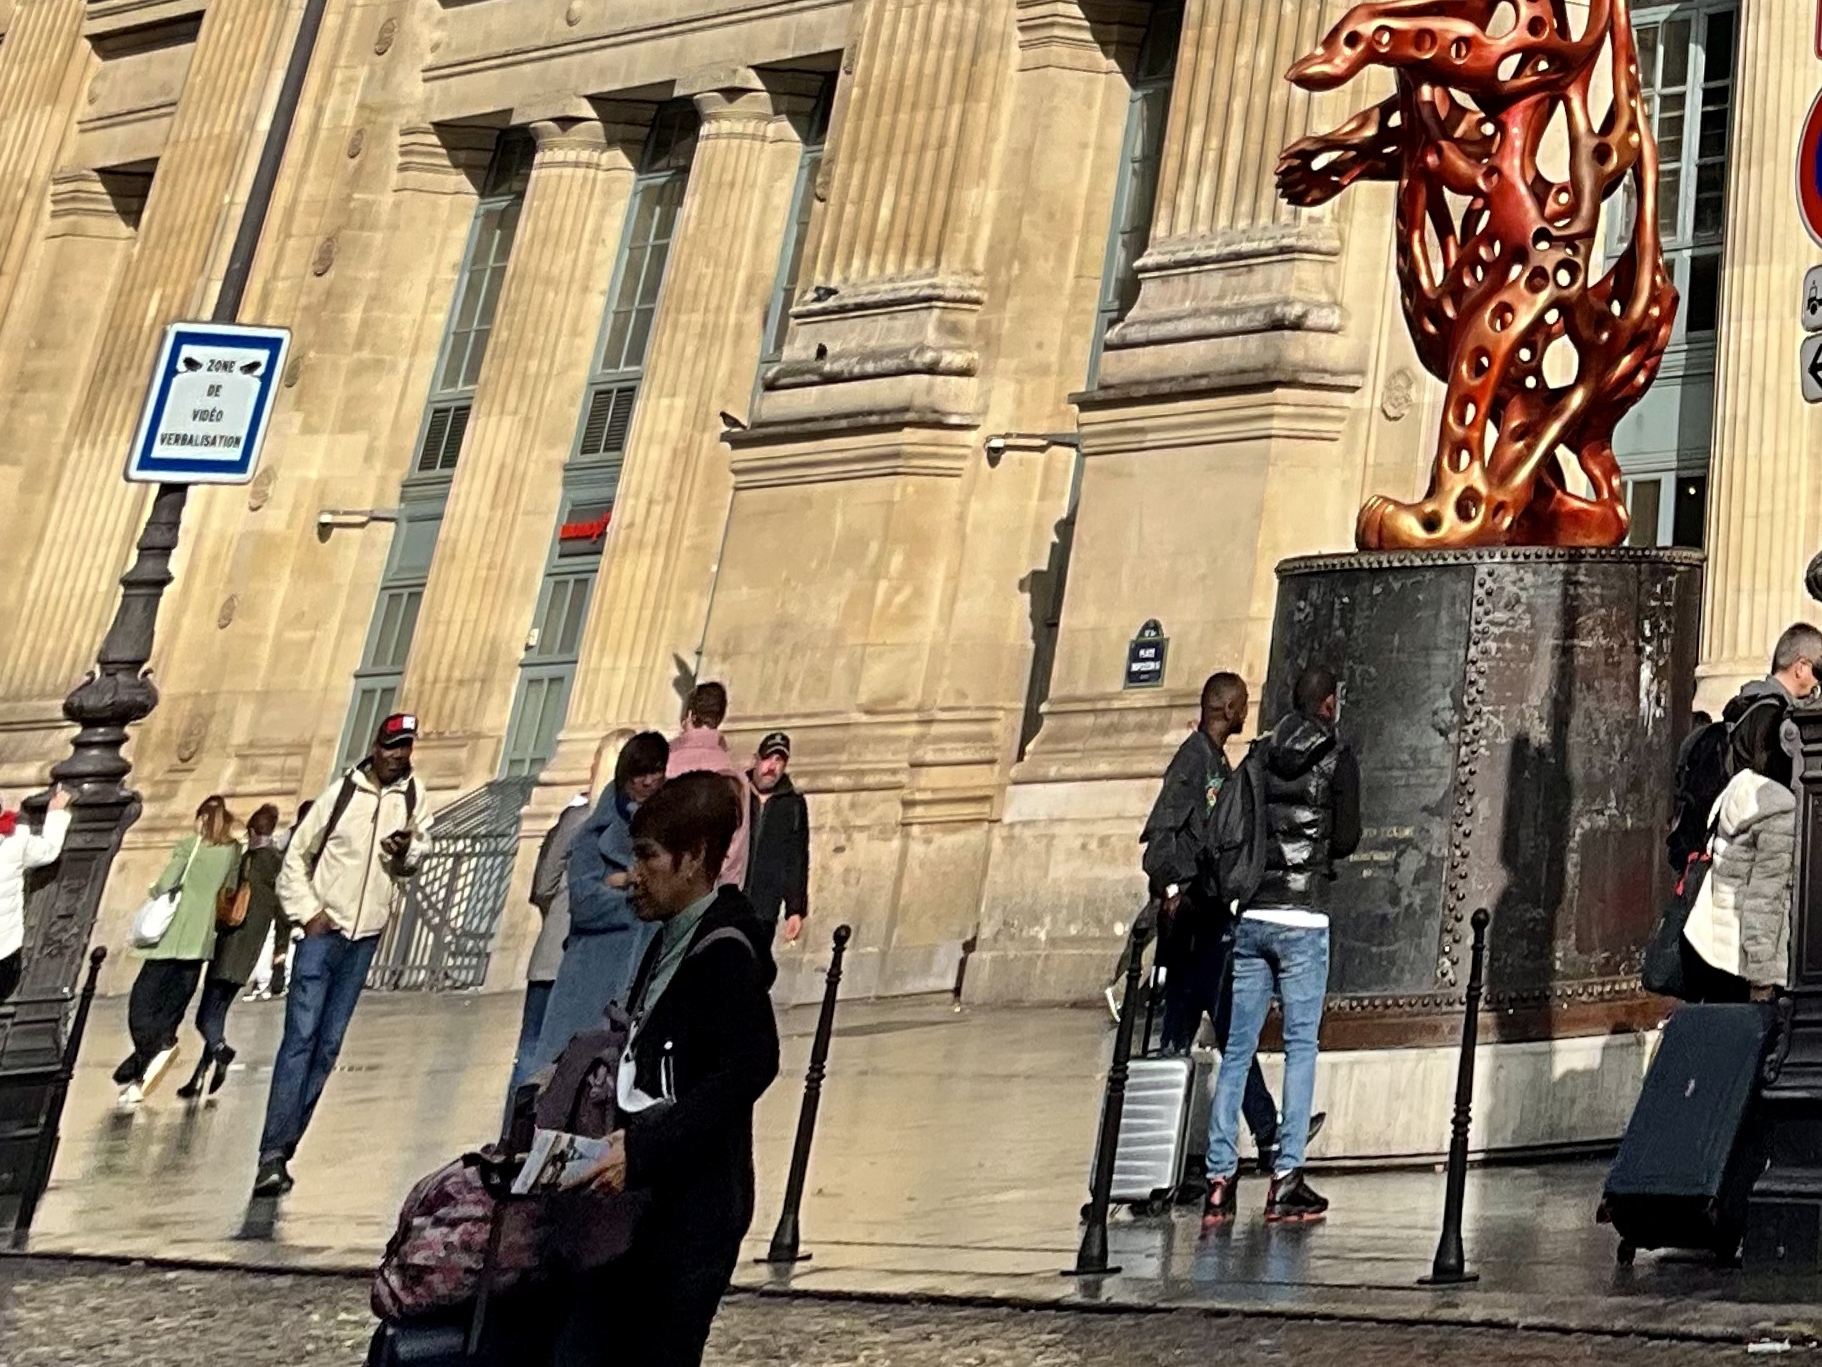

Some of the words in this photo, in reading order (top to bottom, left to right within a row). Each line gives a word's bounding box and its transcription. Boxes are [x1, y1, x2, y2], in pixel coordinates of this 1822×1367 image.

[206, 359, 237, 373] ZONE
[207, 384, 223, 398] DE
[192, 406, 224, 422] VIDÉO
[159, 432, 243, 449] VERBALISATION
